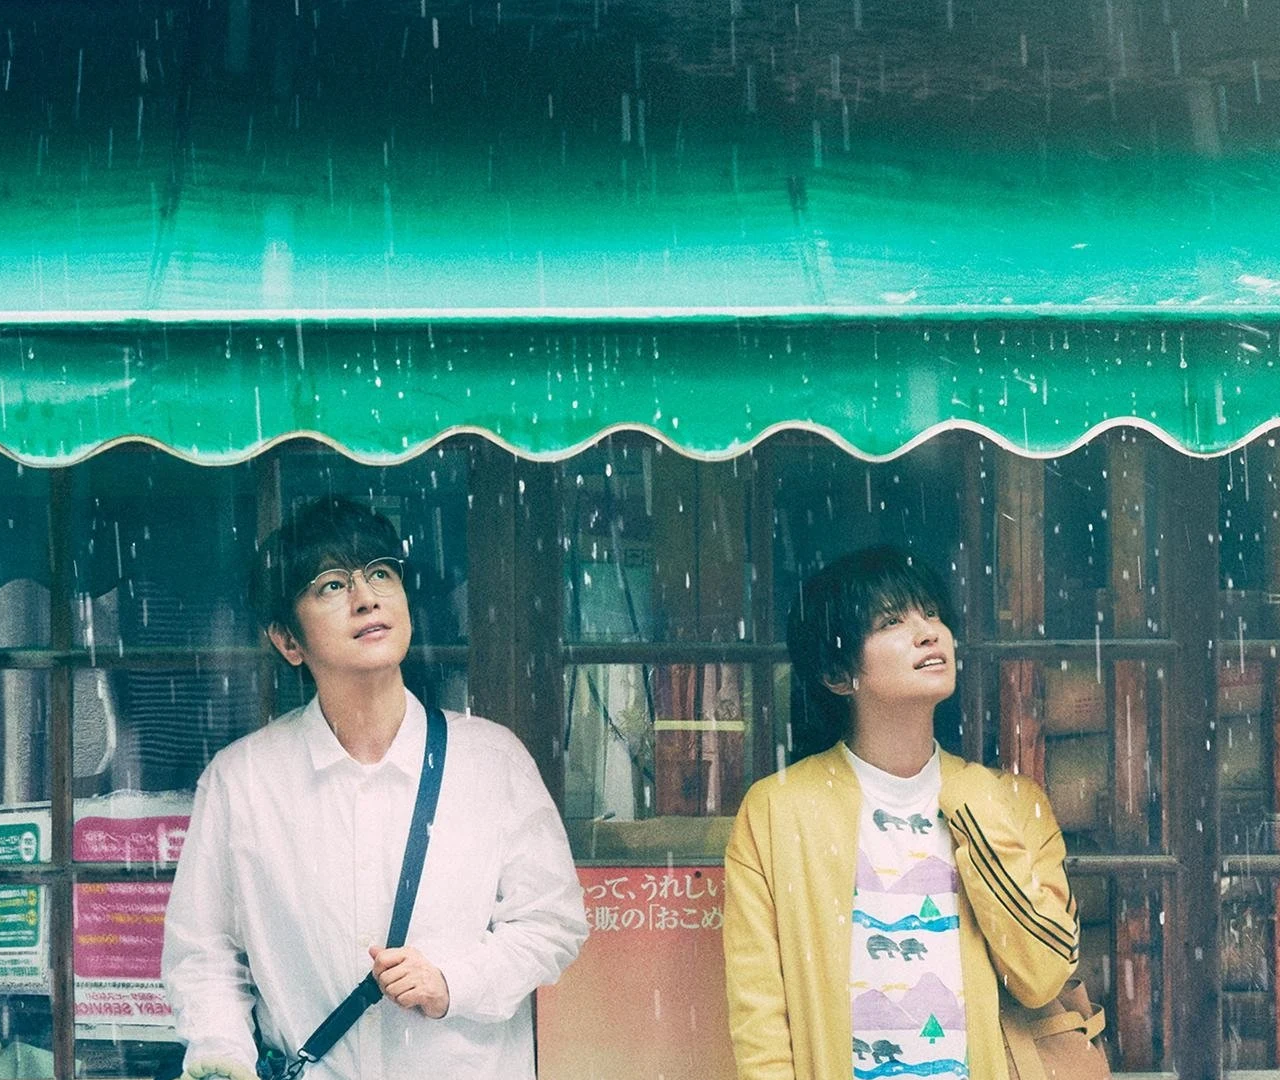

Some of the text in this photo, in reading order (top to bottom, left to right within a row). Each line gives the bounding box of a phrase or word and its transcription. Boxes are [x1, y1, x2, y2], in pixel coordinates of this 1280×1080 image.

[581, 874, 726, 901] って、うれしい
